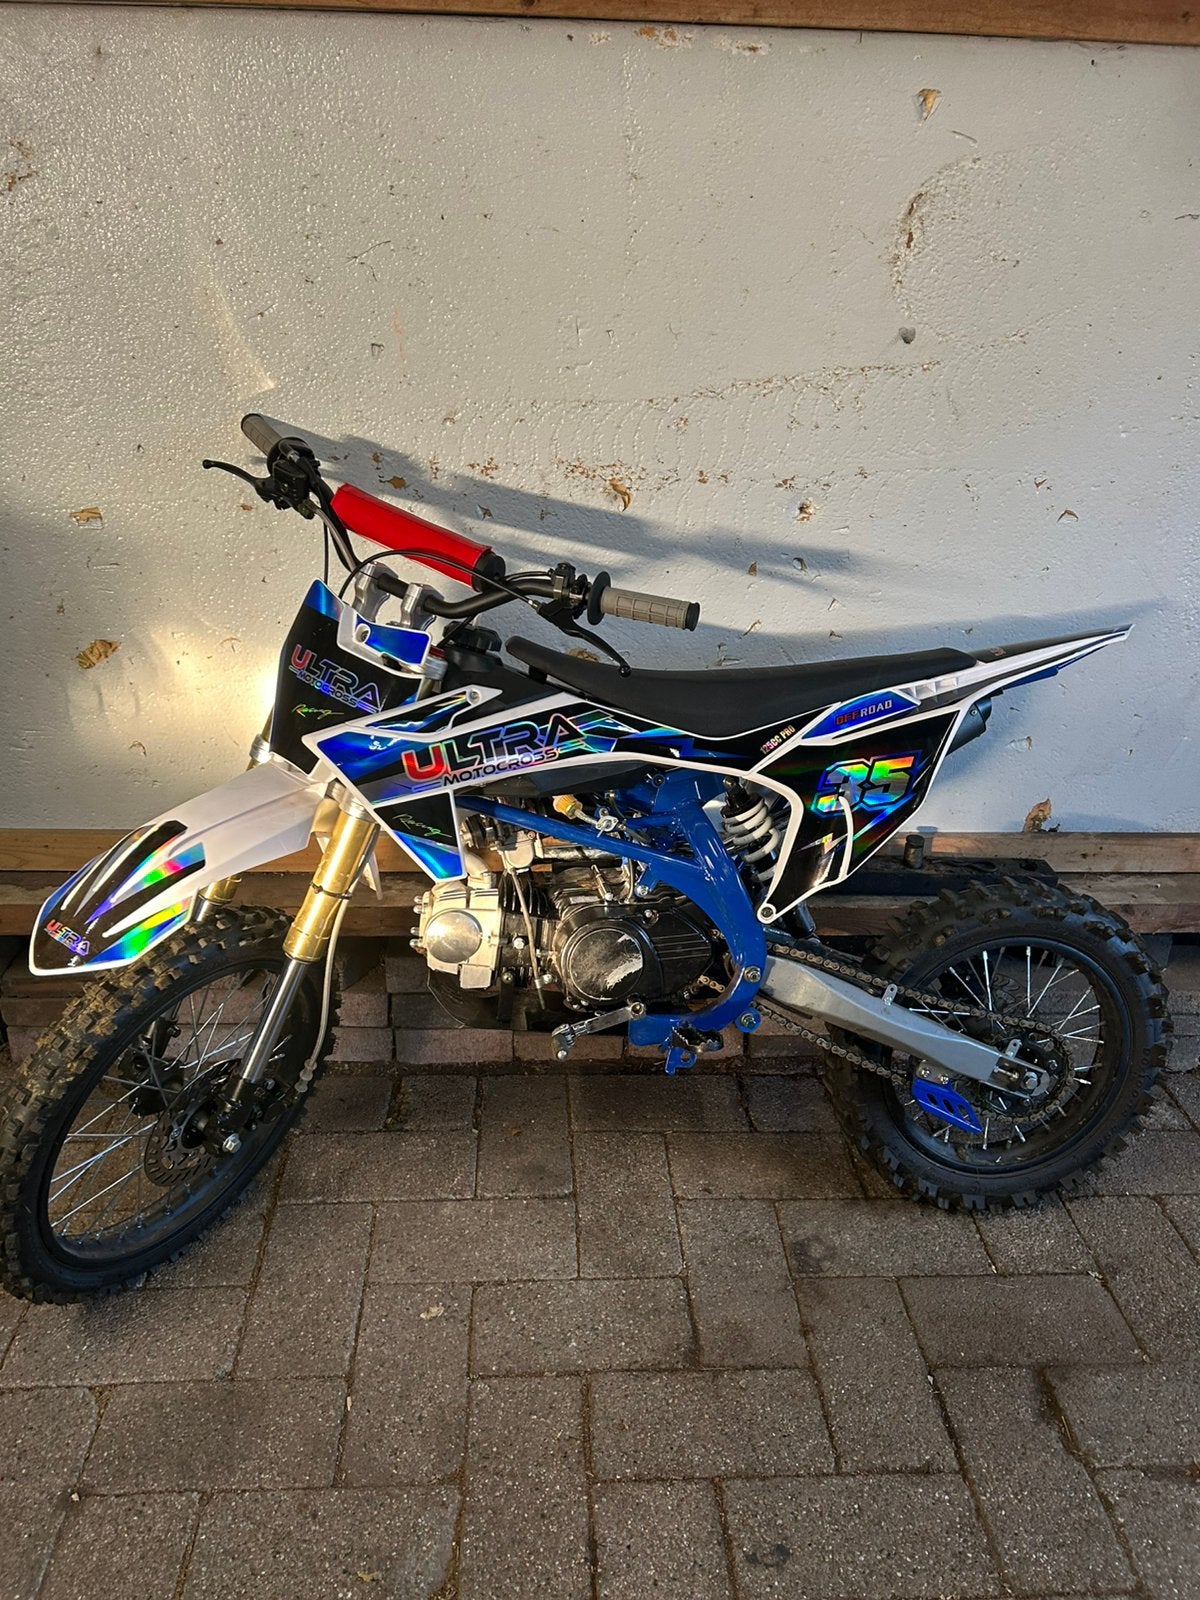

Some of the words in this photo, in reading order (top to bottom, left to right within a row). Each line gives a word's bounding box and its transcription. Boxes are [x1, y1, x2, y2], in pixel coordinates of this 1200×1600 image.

[291, 644, 380, 710] ULTRA
[297, 670, 358, 706] MOTOCROSS
[401, 713, 586, 783] ULTRA
[760, 735, 783, 755] 125CC
[779, 725, 796, 740] PRO
[443, 748, 561, 787] MOTOCROSS
[46, 919, 91, 956] ULTRA
